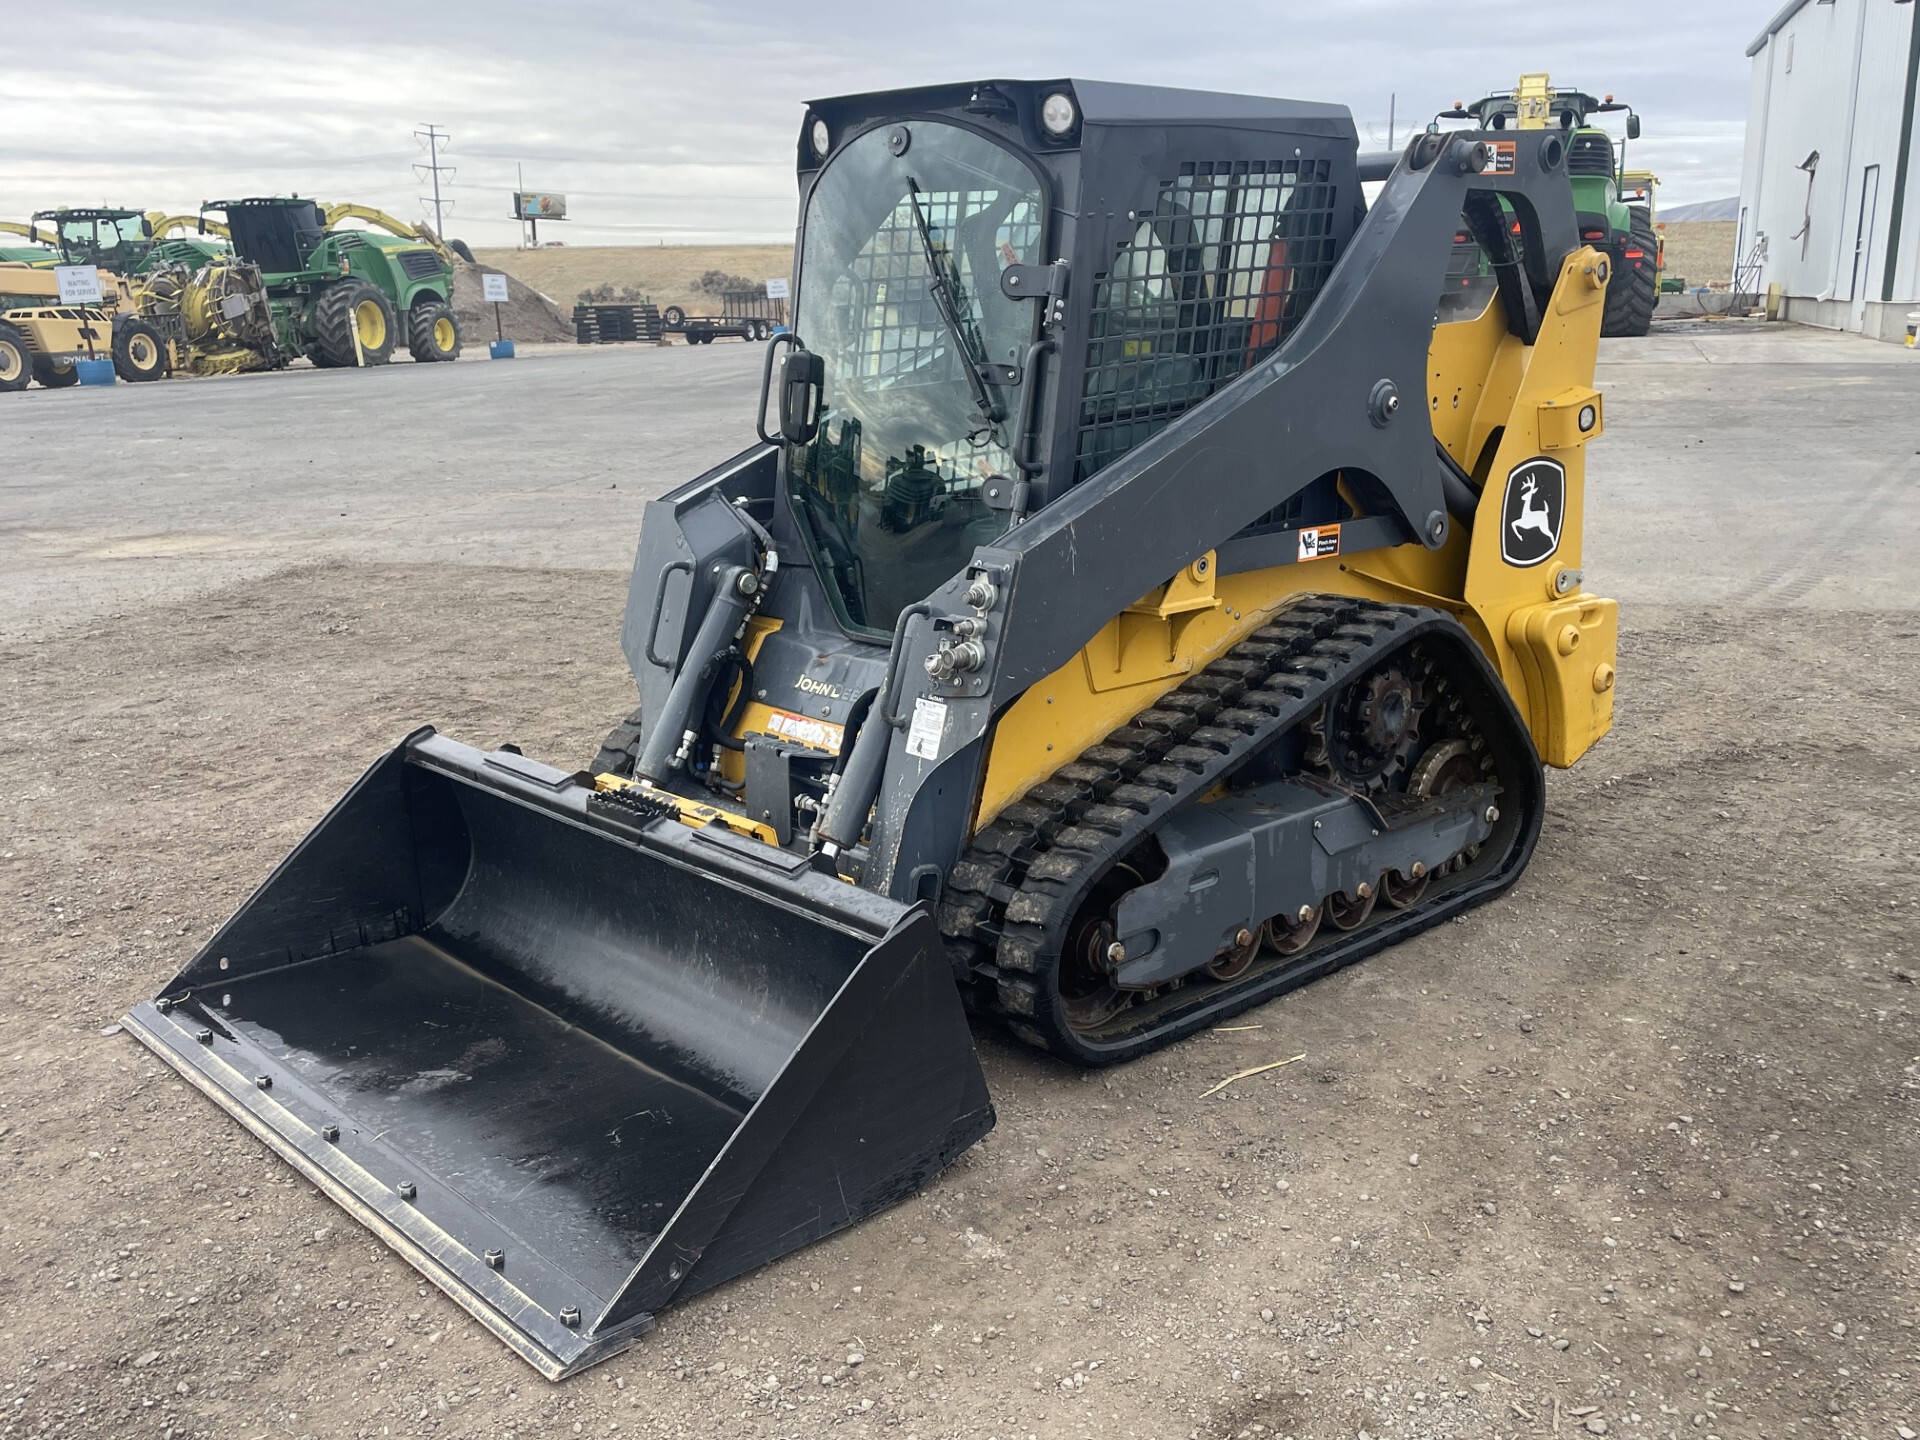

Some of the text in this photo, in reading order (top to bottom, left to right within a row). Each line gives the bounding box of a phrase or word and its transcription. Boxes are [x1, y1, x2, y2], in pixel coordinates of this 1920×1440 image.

[65, 288, 97, 297] FOR SERVICE
[795, 674, 863, 703] JOHN DEE
